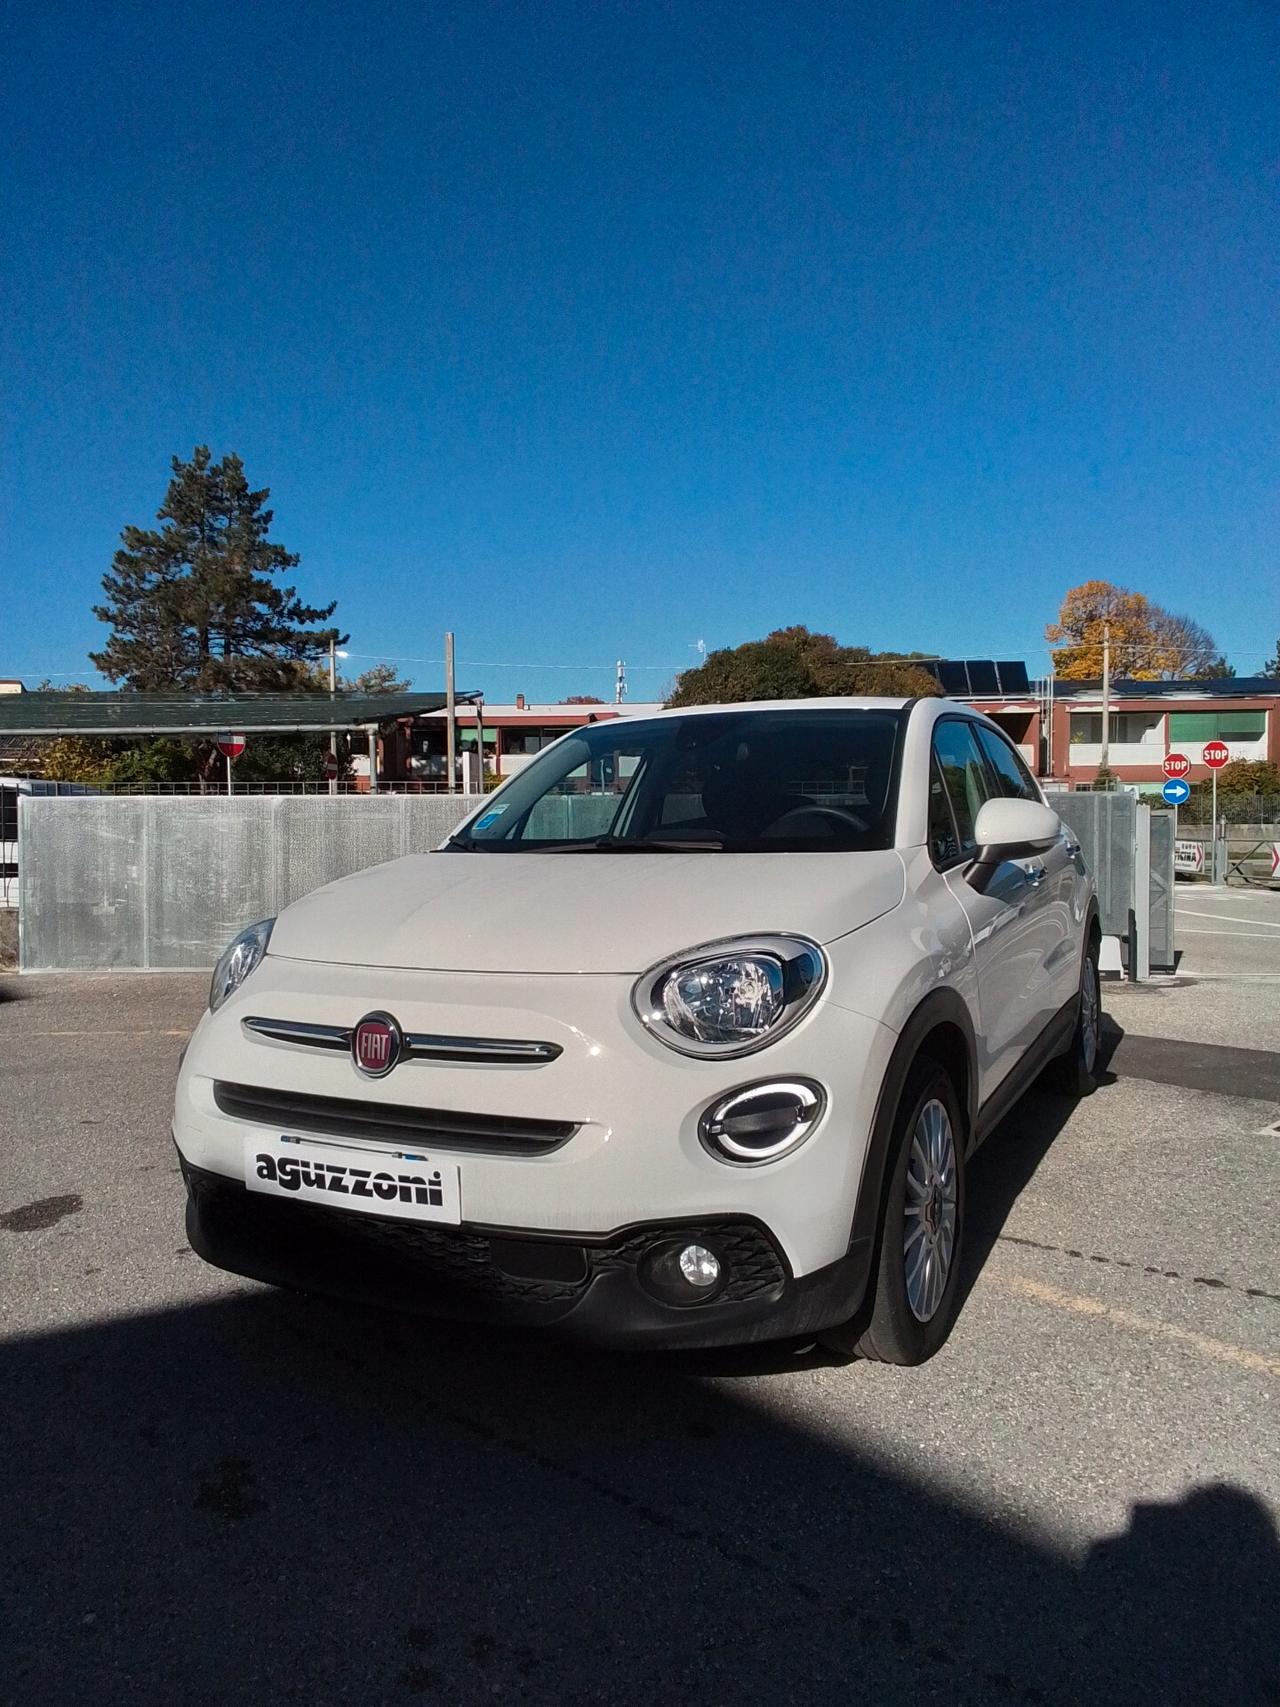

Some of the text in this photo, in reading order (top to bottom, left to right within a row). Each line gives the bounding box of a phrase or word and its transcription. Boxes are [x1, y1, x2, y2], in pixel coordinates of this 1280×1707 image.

[1203, 749, 1228, 760] STOP
[1164, 761, 1187, 770] STOP
[361, 1032, 389, 1060] FIAT
[256, 1153, 443, 1206] aguzzoni
